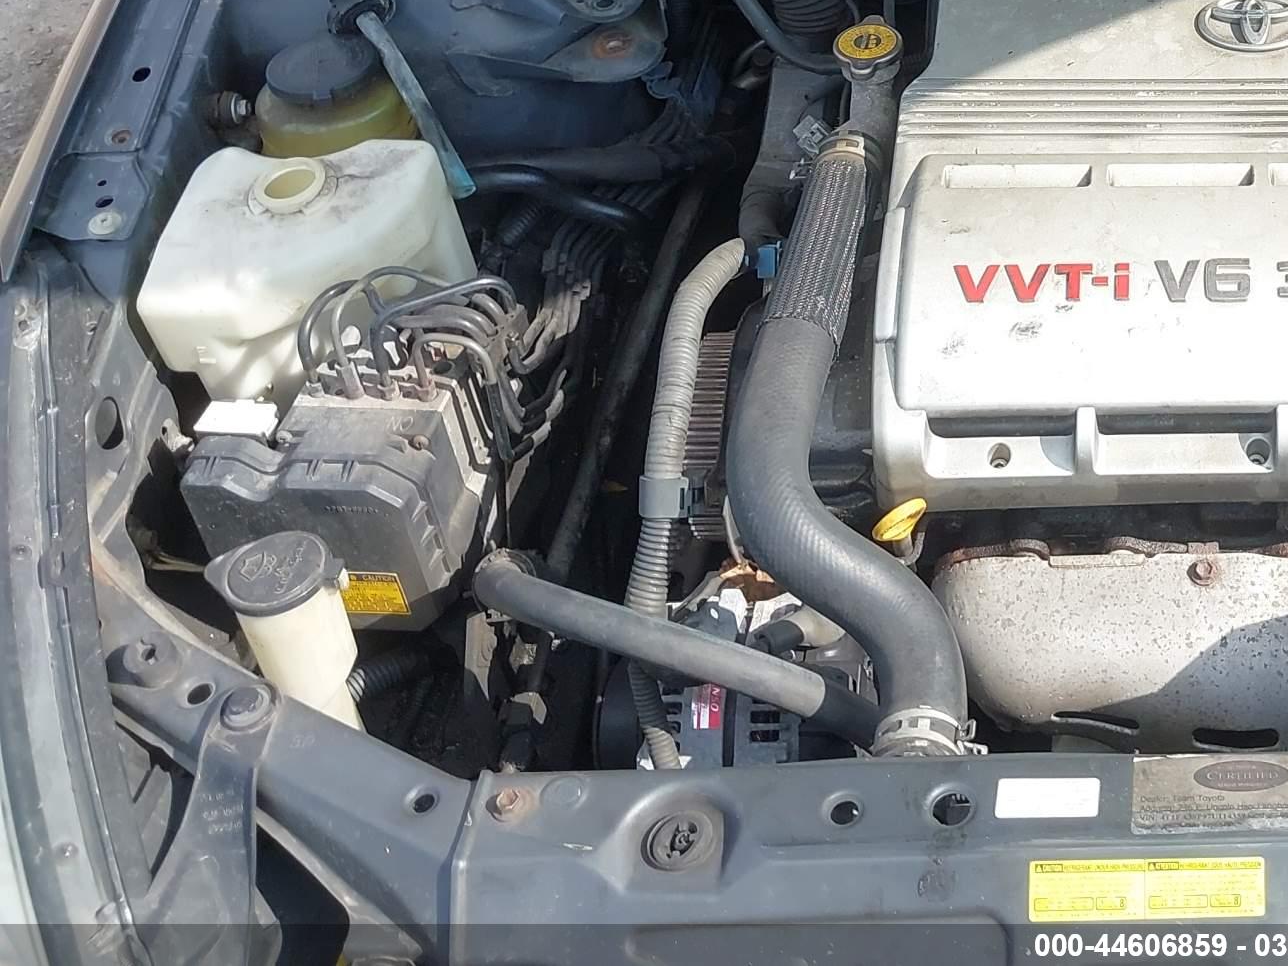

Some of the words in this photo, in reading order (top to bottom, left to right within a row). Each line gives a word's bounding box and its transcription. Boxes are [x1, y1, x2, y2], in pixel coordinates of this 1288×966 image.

[952, 262, 1131, 304] VVT-i
[1154, 257, 1251, 303] V6
[362, 574, 396, 582] CAUTION
[1206, 769, 1280, 781] CERTIFIED
[1172, 794, 1196, 803] Team
[1198, 794, 1226, 804] Toyota
